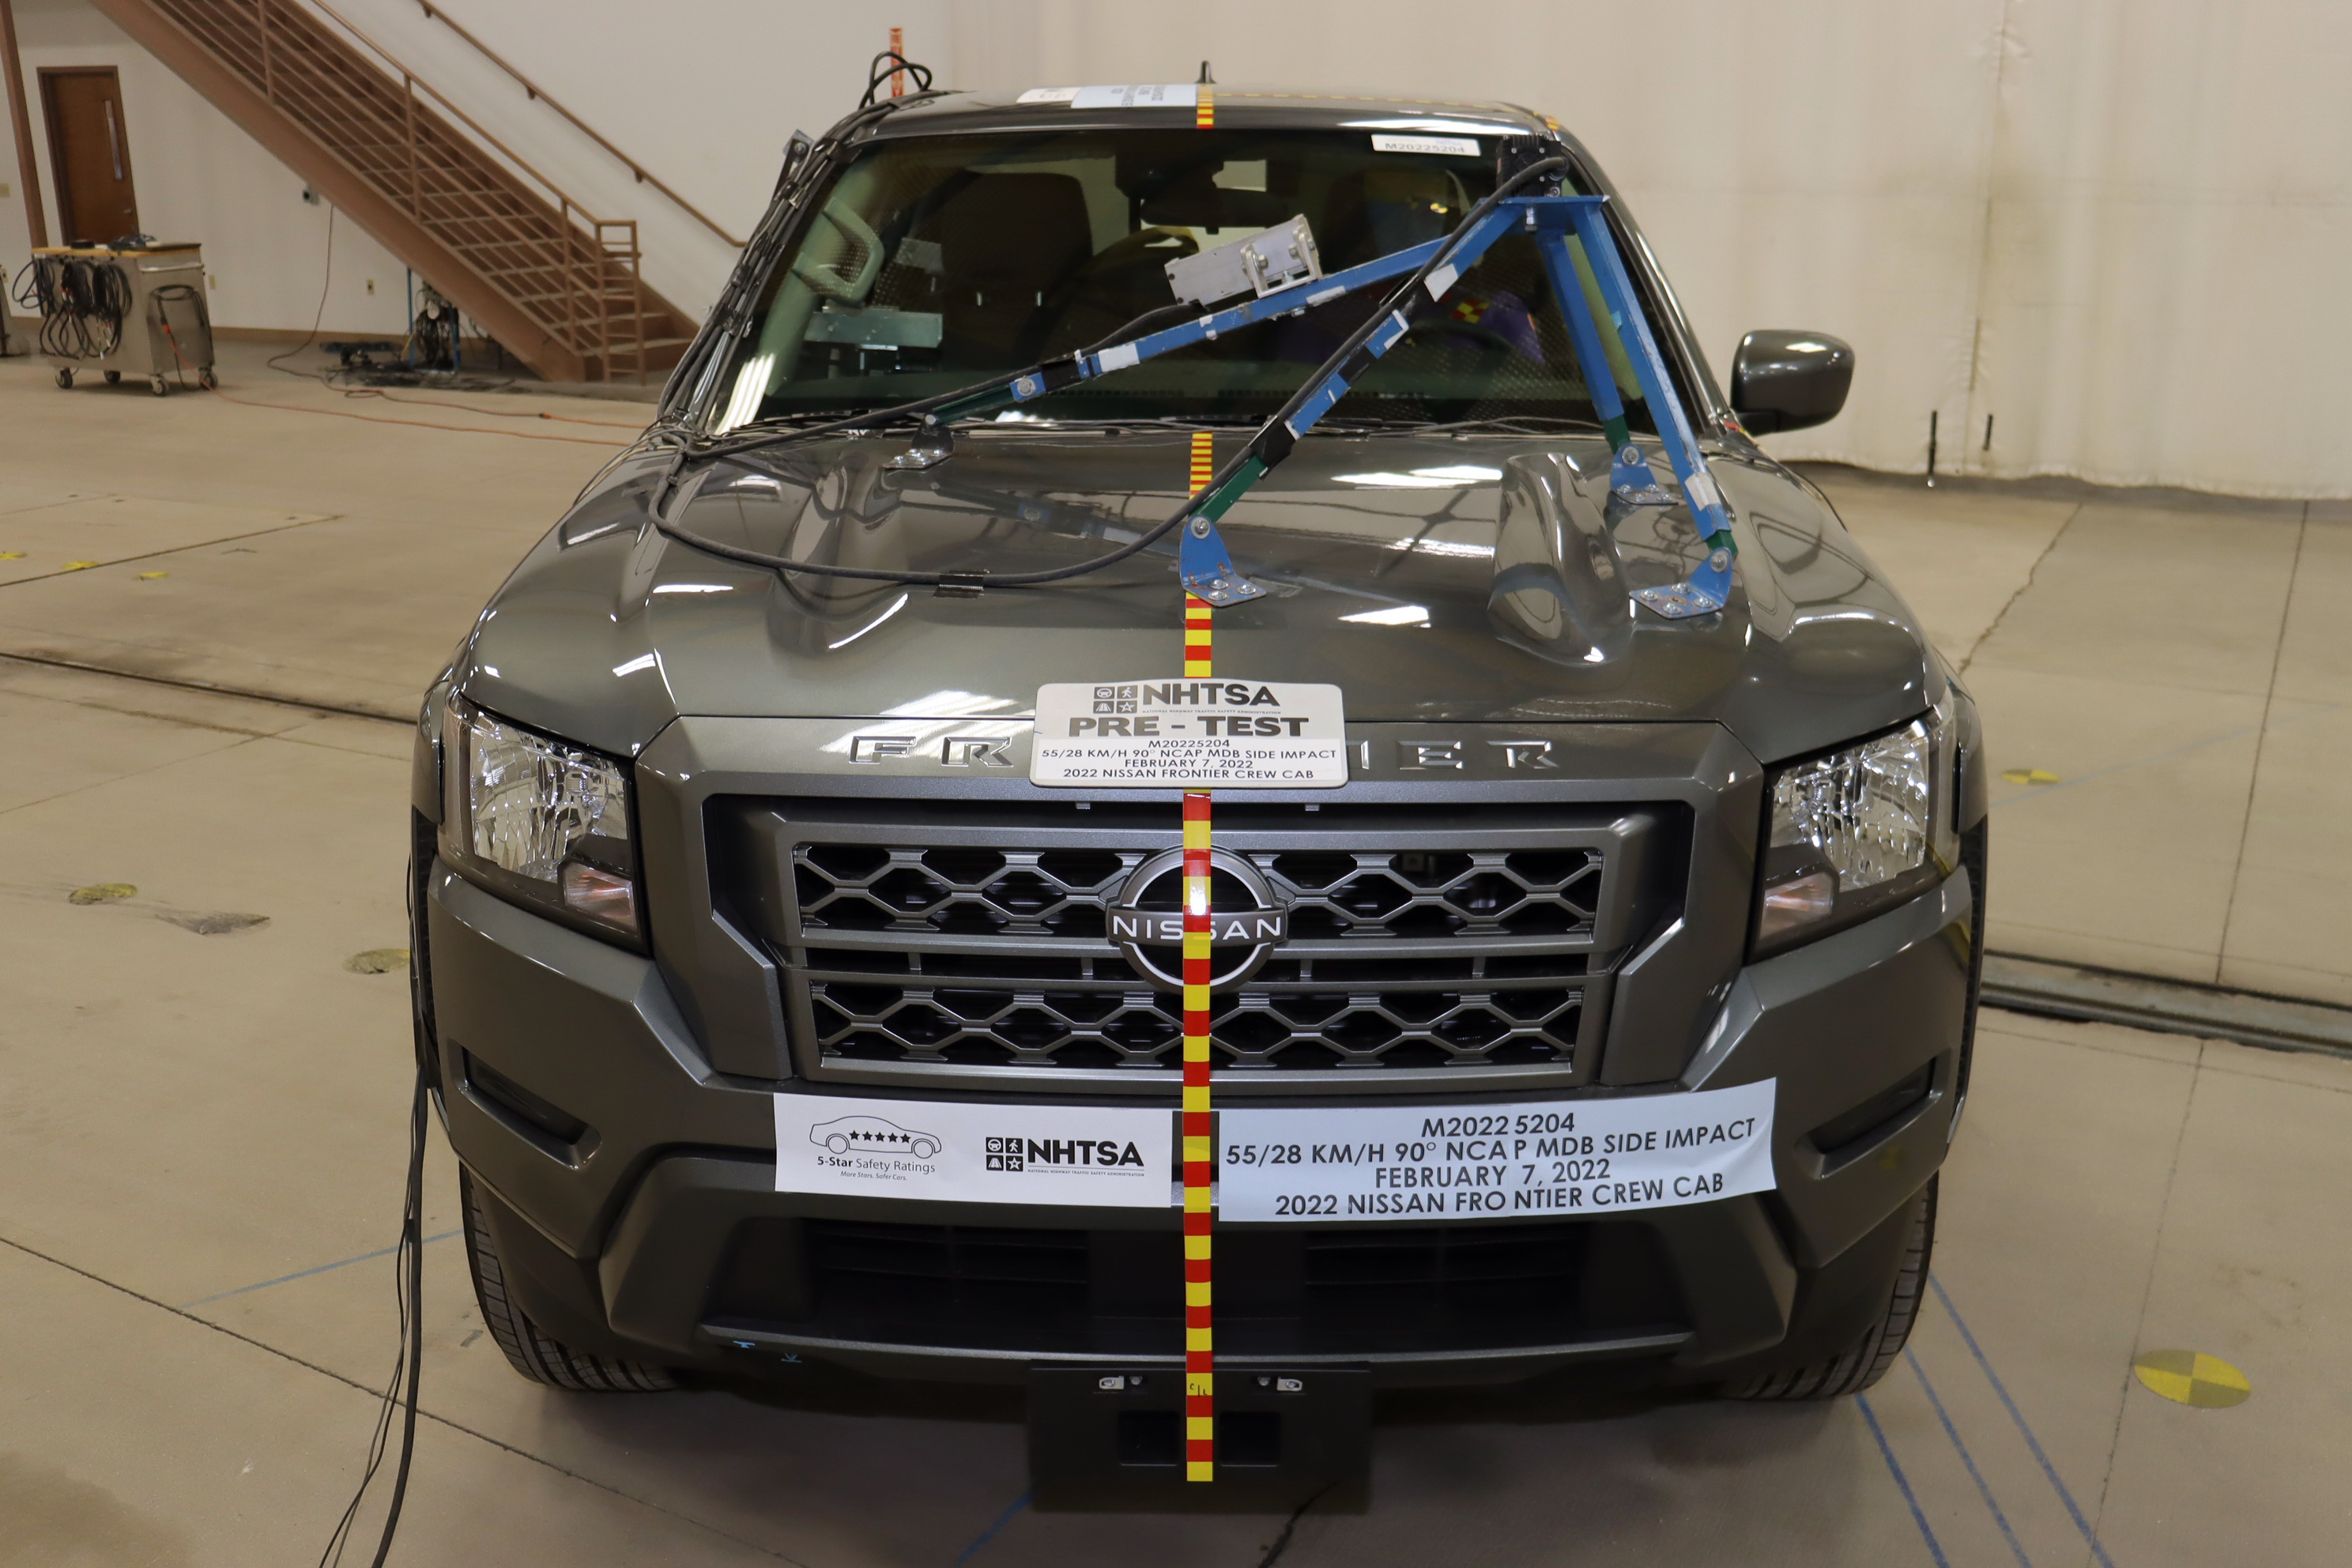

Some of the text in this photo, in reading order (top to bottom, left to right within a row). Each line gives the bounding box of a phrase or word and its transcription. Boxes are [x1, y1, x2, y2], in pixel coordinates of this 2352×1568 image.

[1385, 143, 1464, 153] M20225204
[1144, 684, 1280, 706] NHTSA
[1069, 716, 1159, 737] PRE
[1197, 716, 1309, 737] TEST
[849, 736, 1559, 770] FRIER
[1220, 760, 1253, 768] 2022
[1028, 1139, 1144, 1167] NHTSA
[1227, 1144, 1301, 1167] 55/28
[1313, 1144, 1384, 1166] KM/H
[1396, 1142, 1436, 1162] 90°
[1536, 1136, 1593, 1157] MDB
[1604, 1132, 1657, 1153] SIDE
[1666, 1118, 1755, 1148] IMPACT
[818, 1156, 935, 1174] 5-Star Safety Ratings
[1376, 1159, 1610, 1188] FEBRUARY 7, 2022
[1276, 1173, 1723, 1215] 2022 NISSAN FRONTIER CREW CAB
